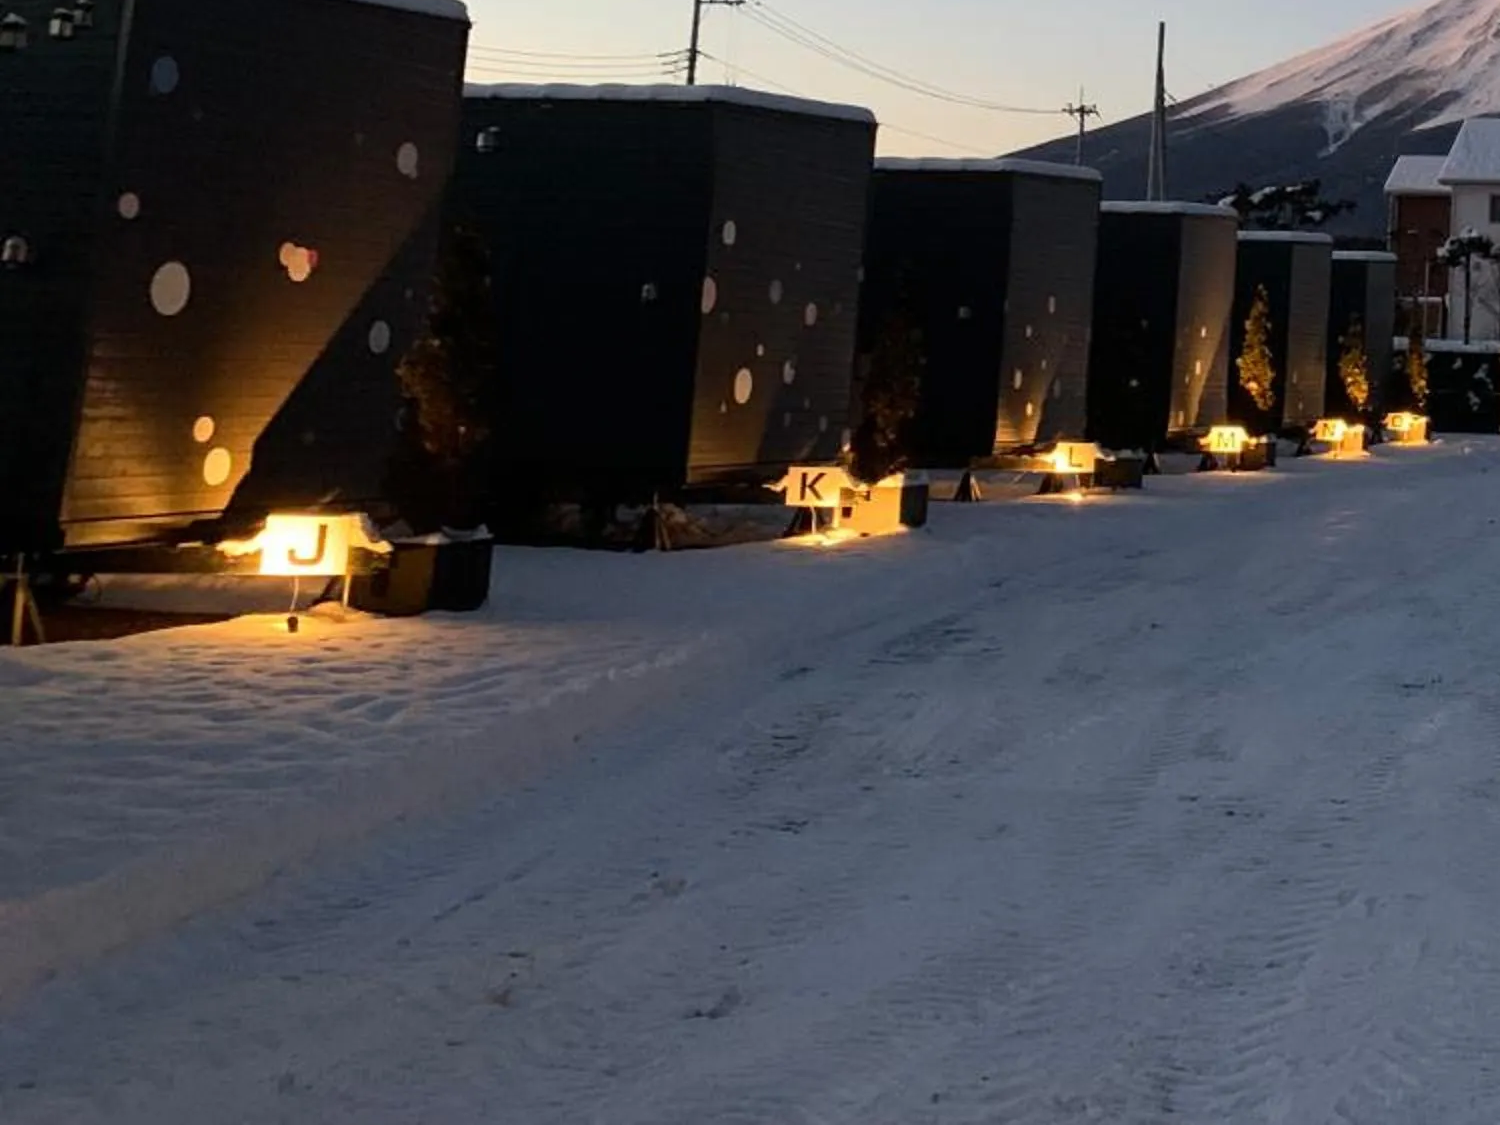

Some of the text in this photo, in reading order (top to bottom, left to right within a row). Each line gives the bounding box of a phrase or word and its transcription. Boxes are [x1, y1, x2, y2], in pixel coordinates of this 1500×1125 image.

[1216, 431, 1236, 447] M
[1068, 446, 1083, 468] L
[800, 472, 826, 501] K
[288, 524, 328, 566] J
